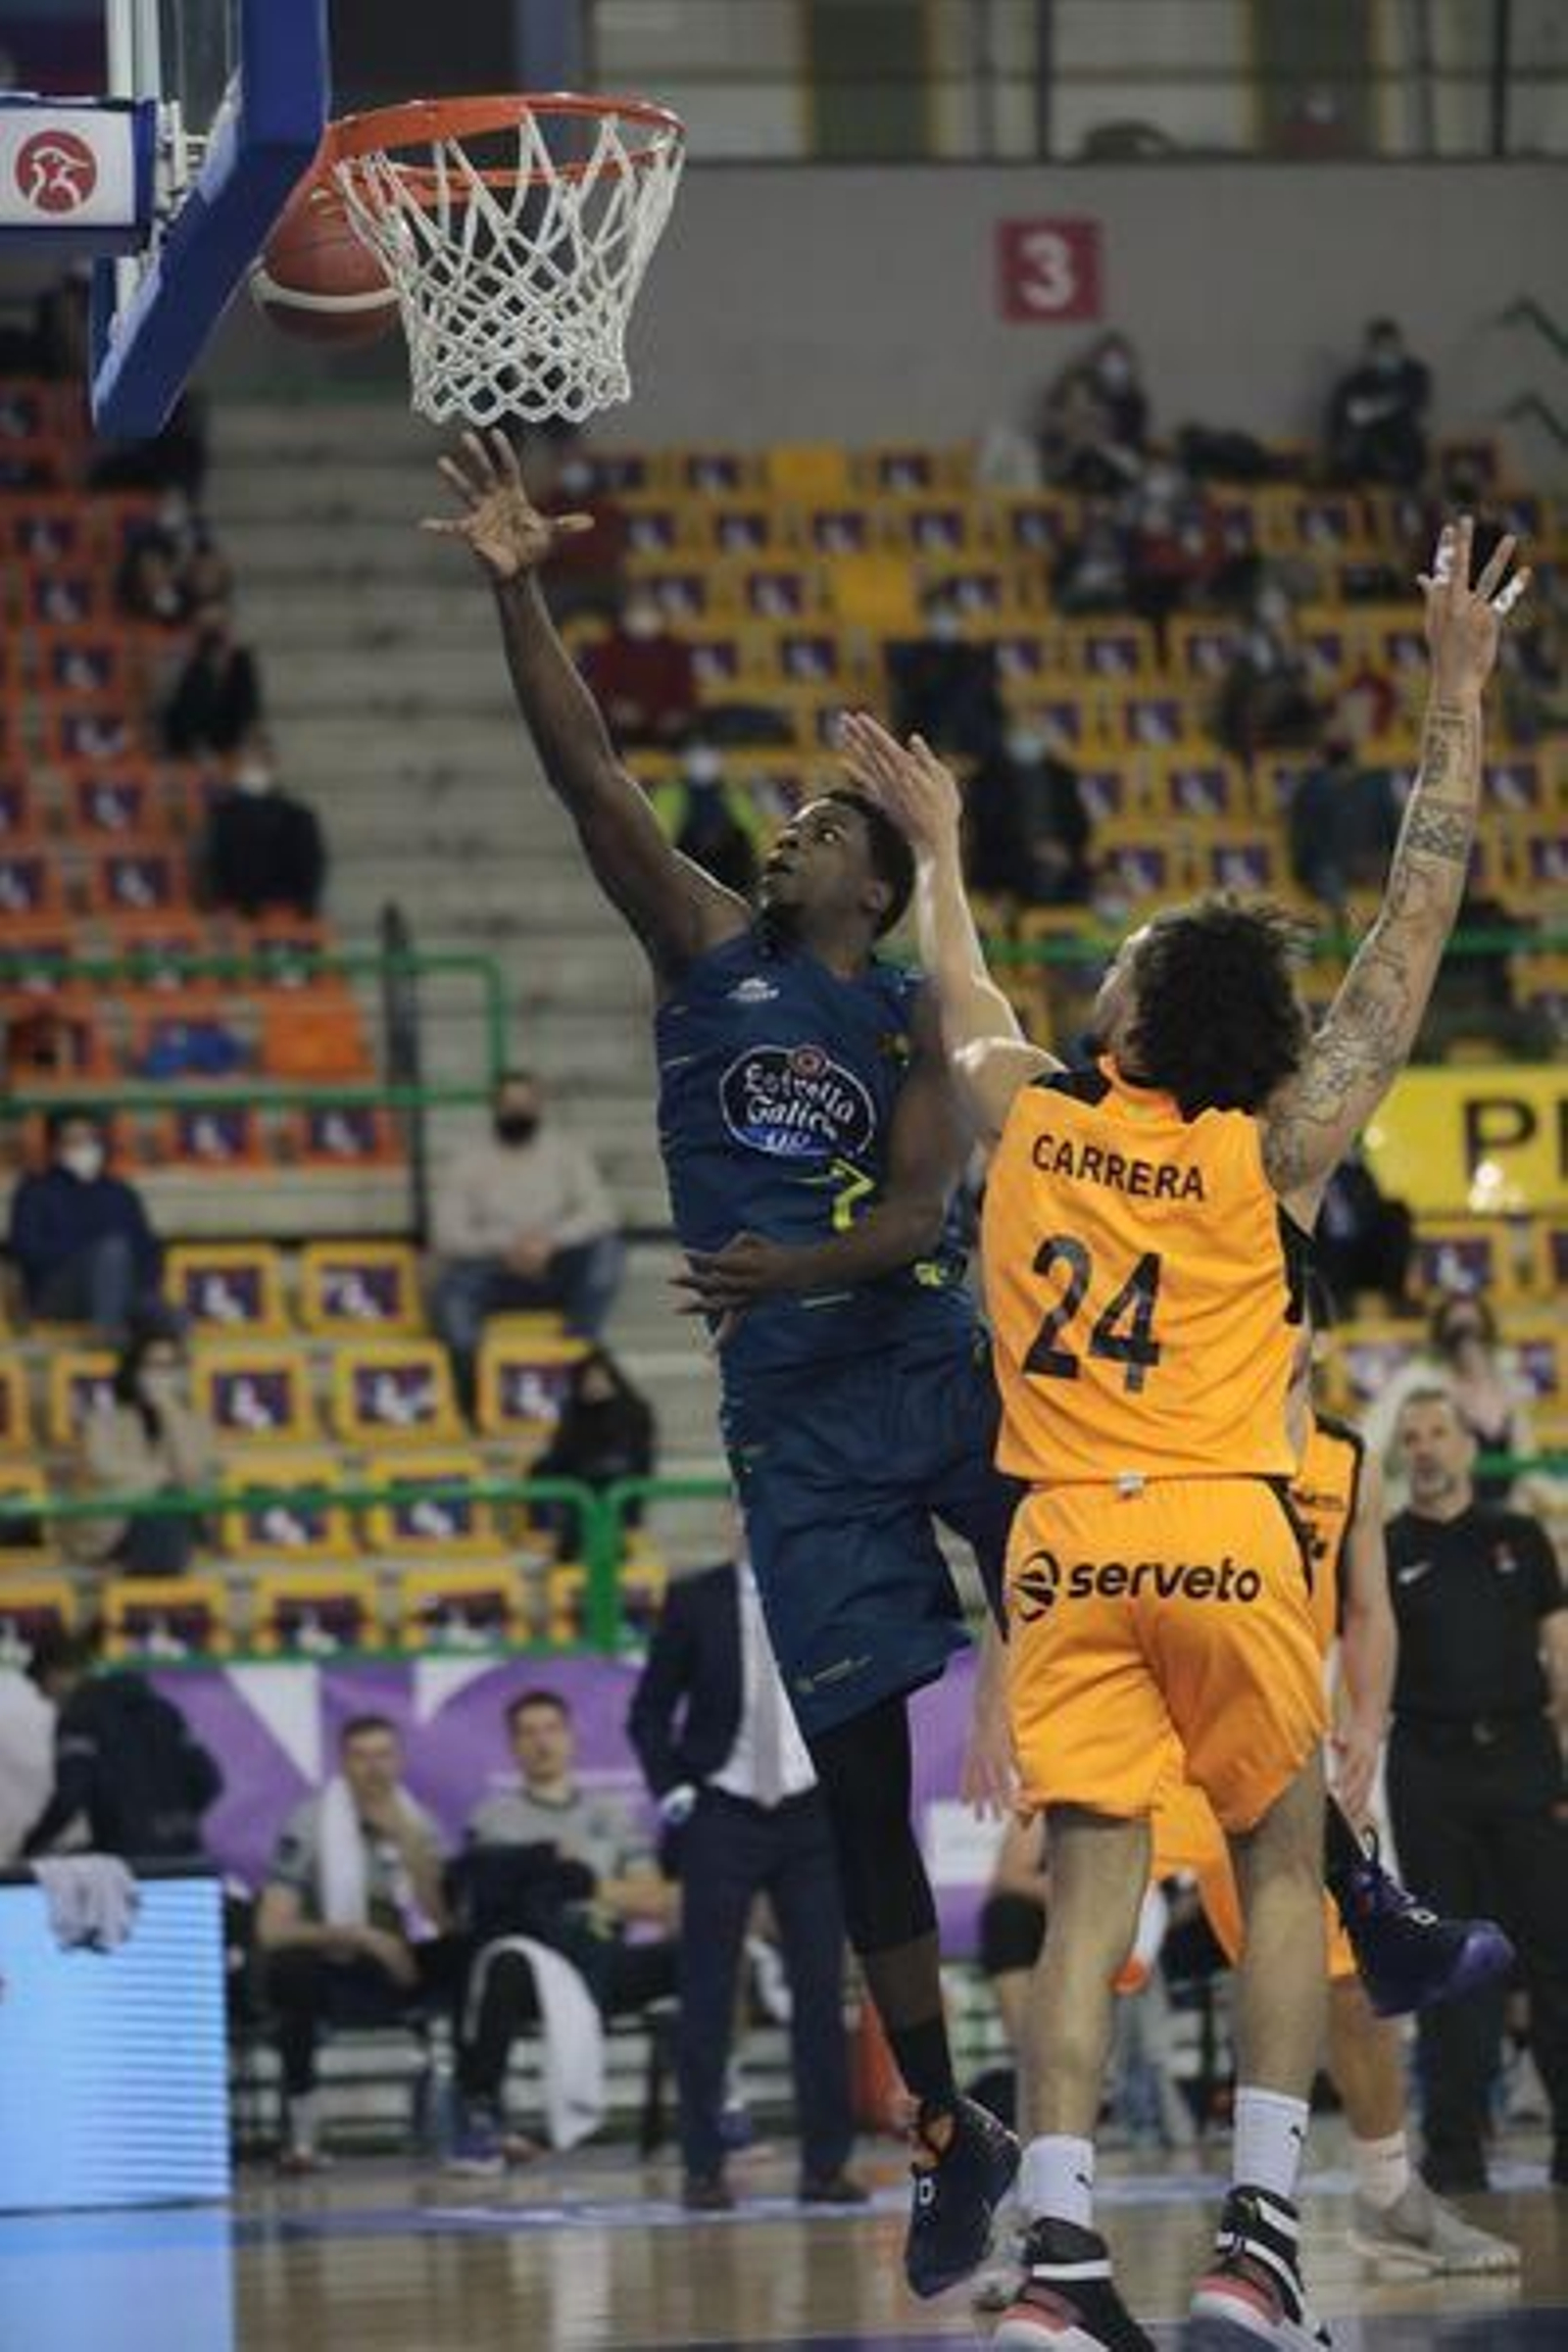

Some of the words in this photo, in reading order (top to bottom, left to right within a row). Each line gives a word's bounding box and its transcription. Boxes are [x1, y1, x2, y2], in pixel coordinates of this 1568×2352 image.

[1021, 233, 1076, 310] 3
[1032, 1133, 1204, 1202] CARRERA
[1022, 1234, 1163, 1395] 24
[1067, 1556, 1262, 1602] serveto
